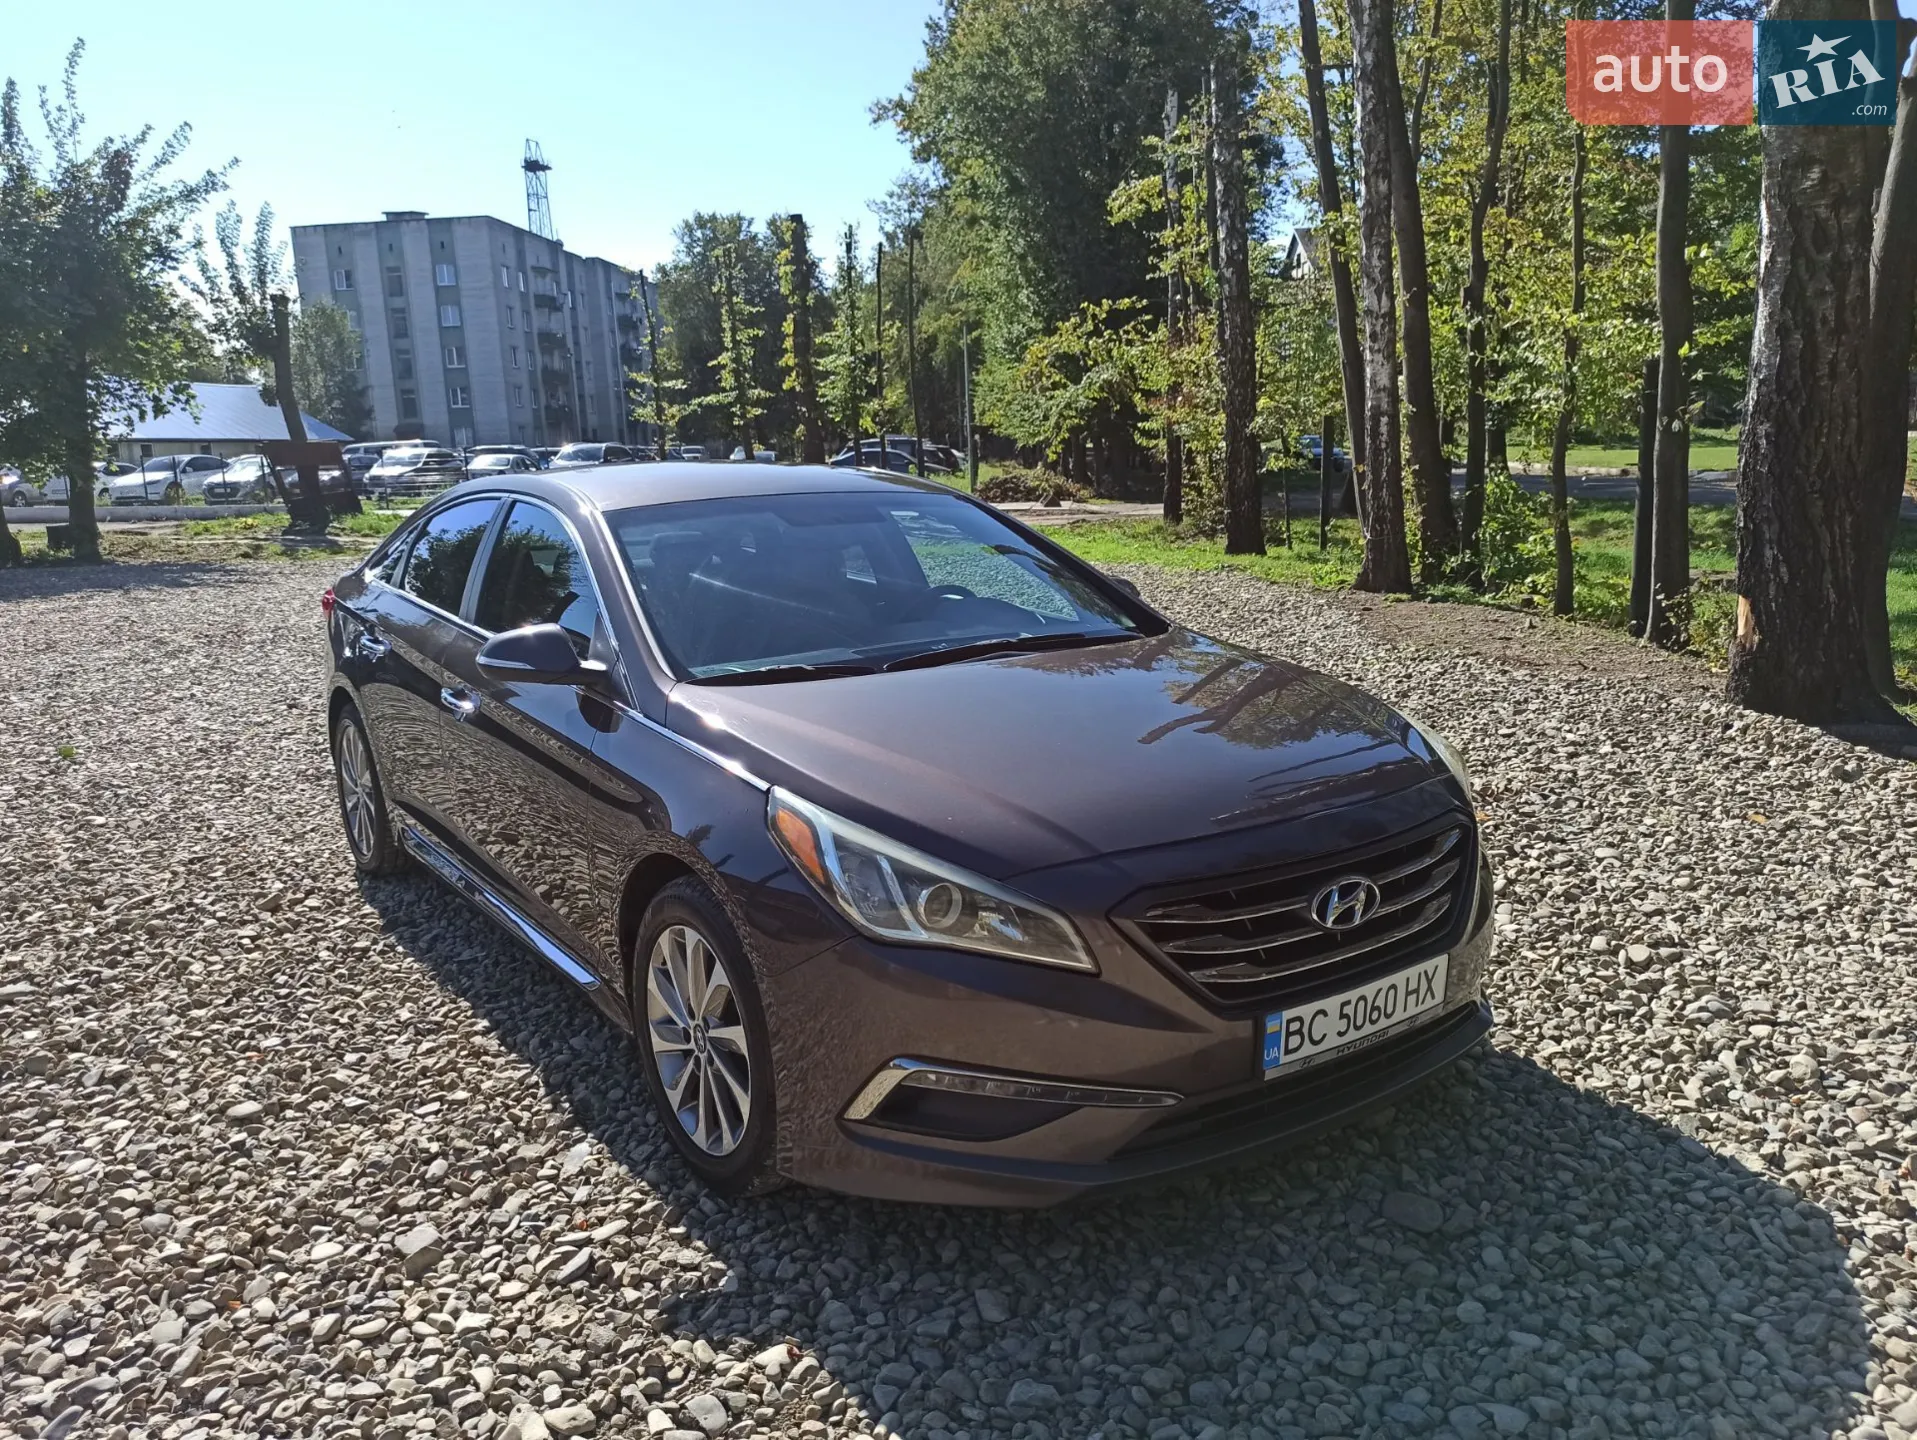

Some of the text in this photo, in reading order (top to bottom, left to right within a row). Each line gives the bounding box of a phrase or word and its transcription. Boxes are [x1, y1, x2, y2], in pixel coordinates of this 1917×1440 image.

[1284, 965, 1439, 1056] BC 5060 HX
[1264, 1047, 1279, 1061] UA
